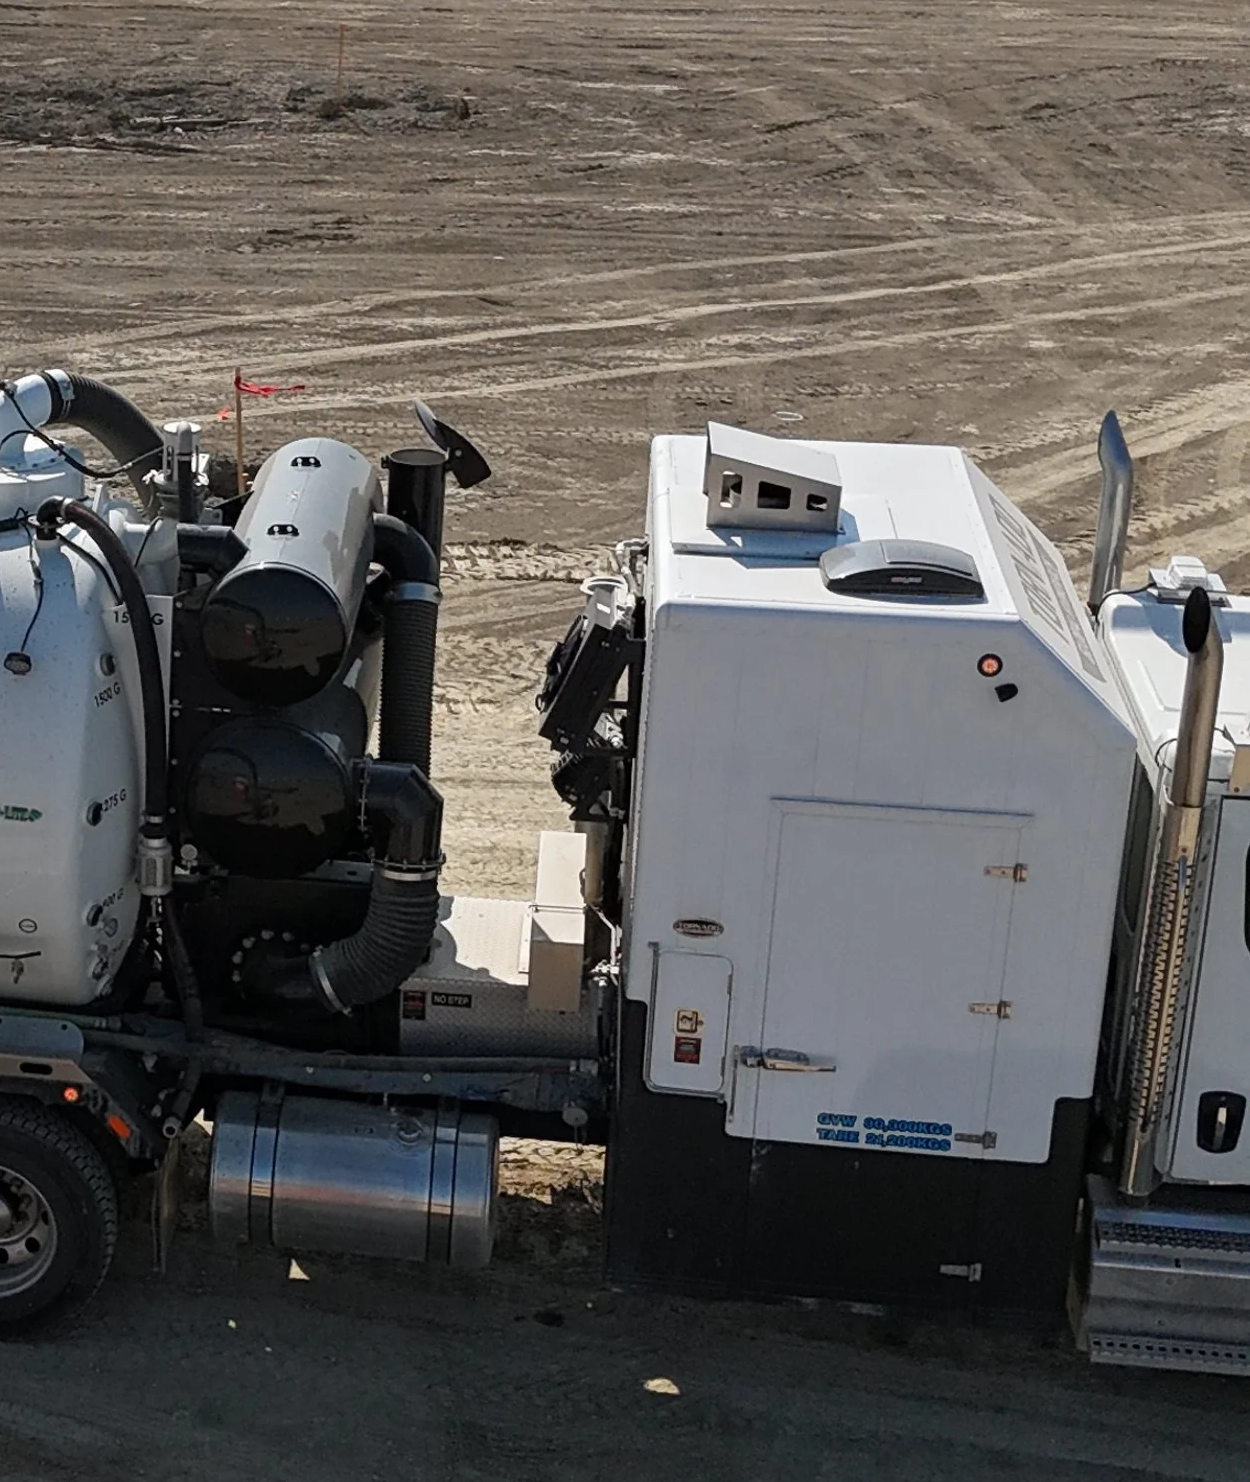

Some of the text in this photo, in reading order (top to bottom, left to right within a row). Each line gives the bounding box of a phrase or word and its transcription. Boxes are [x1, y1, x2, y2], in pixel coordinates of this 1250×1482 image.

[152, 613, 164, 626] G
[433, 994, 446, 1004] NO
[817, 1113, 857, 1127] GVW
[816, 1128, 859, 1143] TARE
